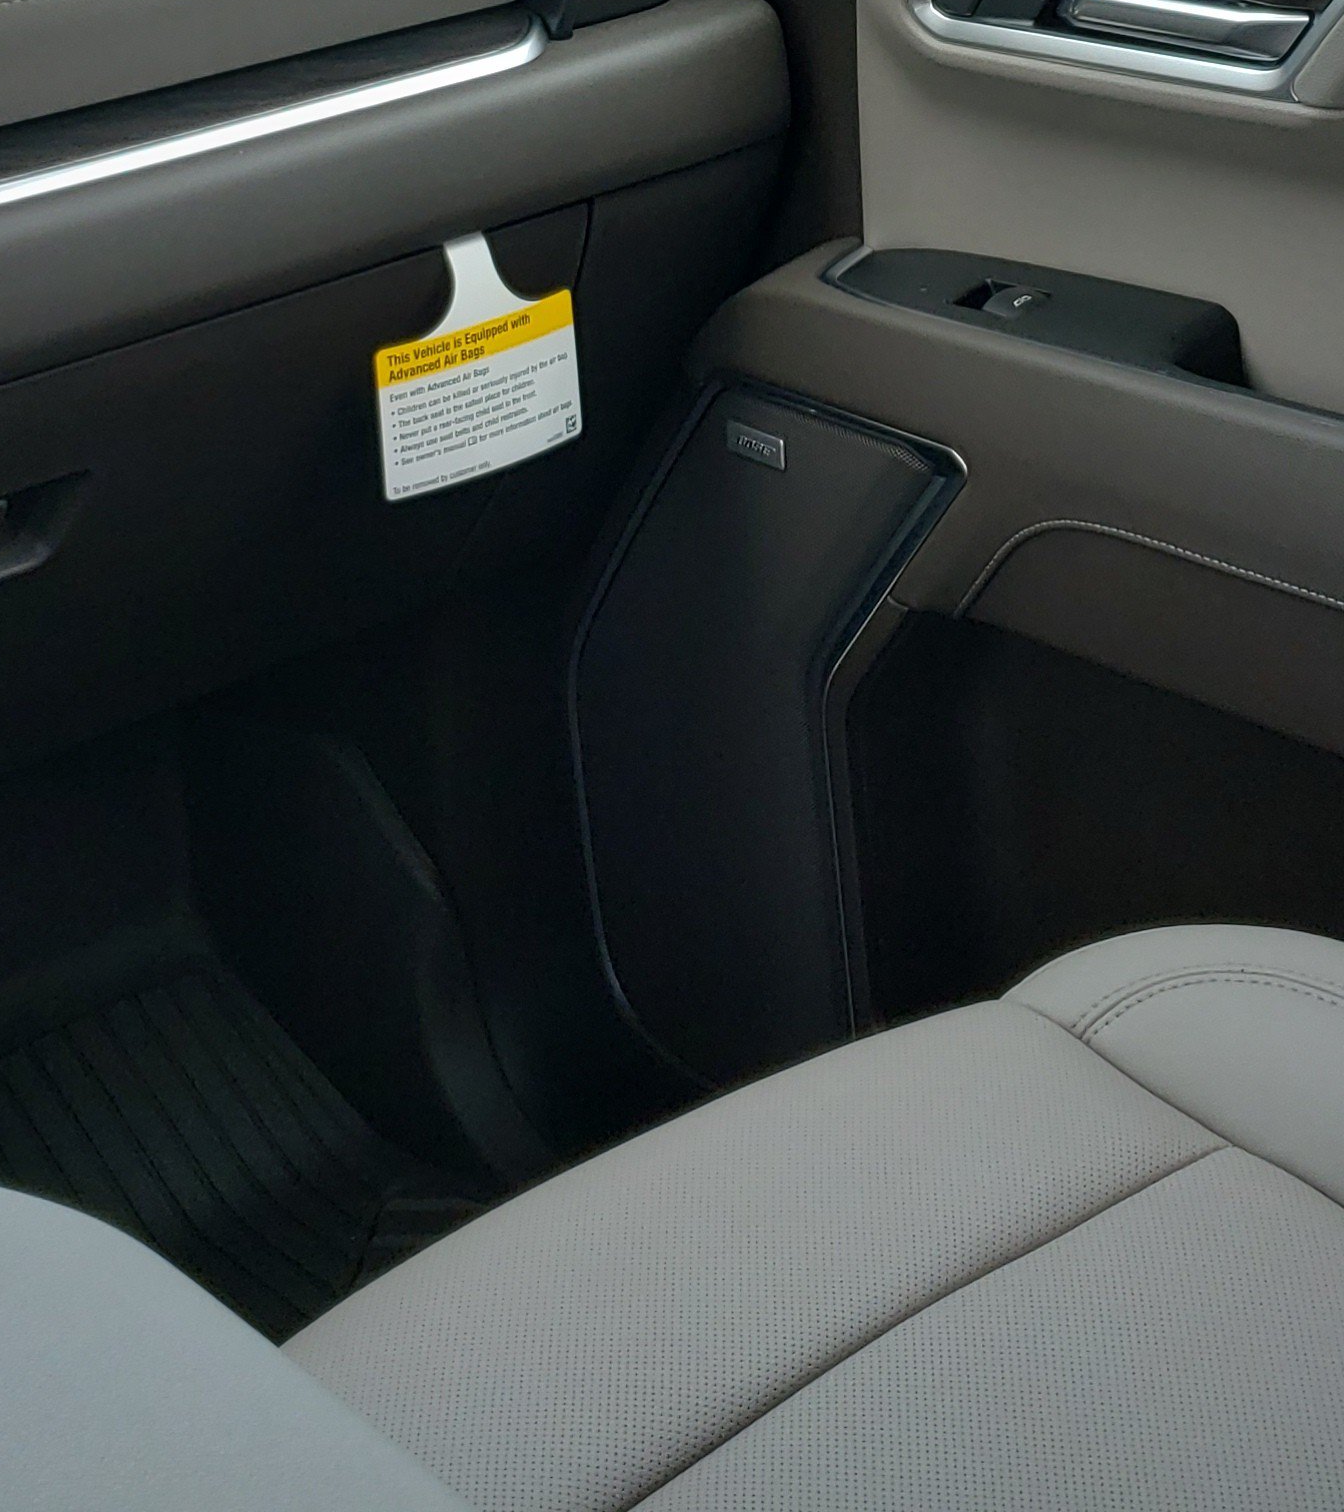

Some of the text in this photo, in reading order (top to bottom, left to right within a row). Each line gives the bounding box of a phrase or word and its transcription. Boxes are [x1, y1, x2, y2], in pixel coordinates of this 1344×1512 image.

[387, 313, 531, 367] This Vehicle is Equipped with
[389, 345, 485, 382] Advanced Air Bags
[390, 367, 489, 402] Even with Advanced Air Bags
[397, 402, 427, 415] Children
[428, 398, 441, 407] can
[453, 388, 471, 400] killed
[398, 419, 411, 428] The
[399, 431, 419, 440] Never
[400, 441, 424, 454] Always
